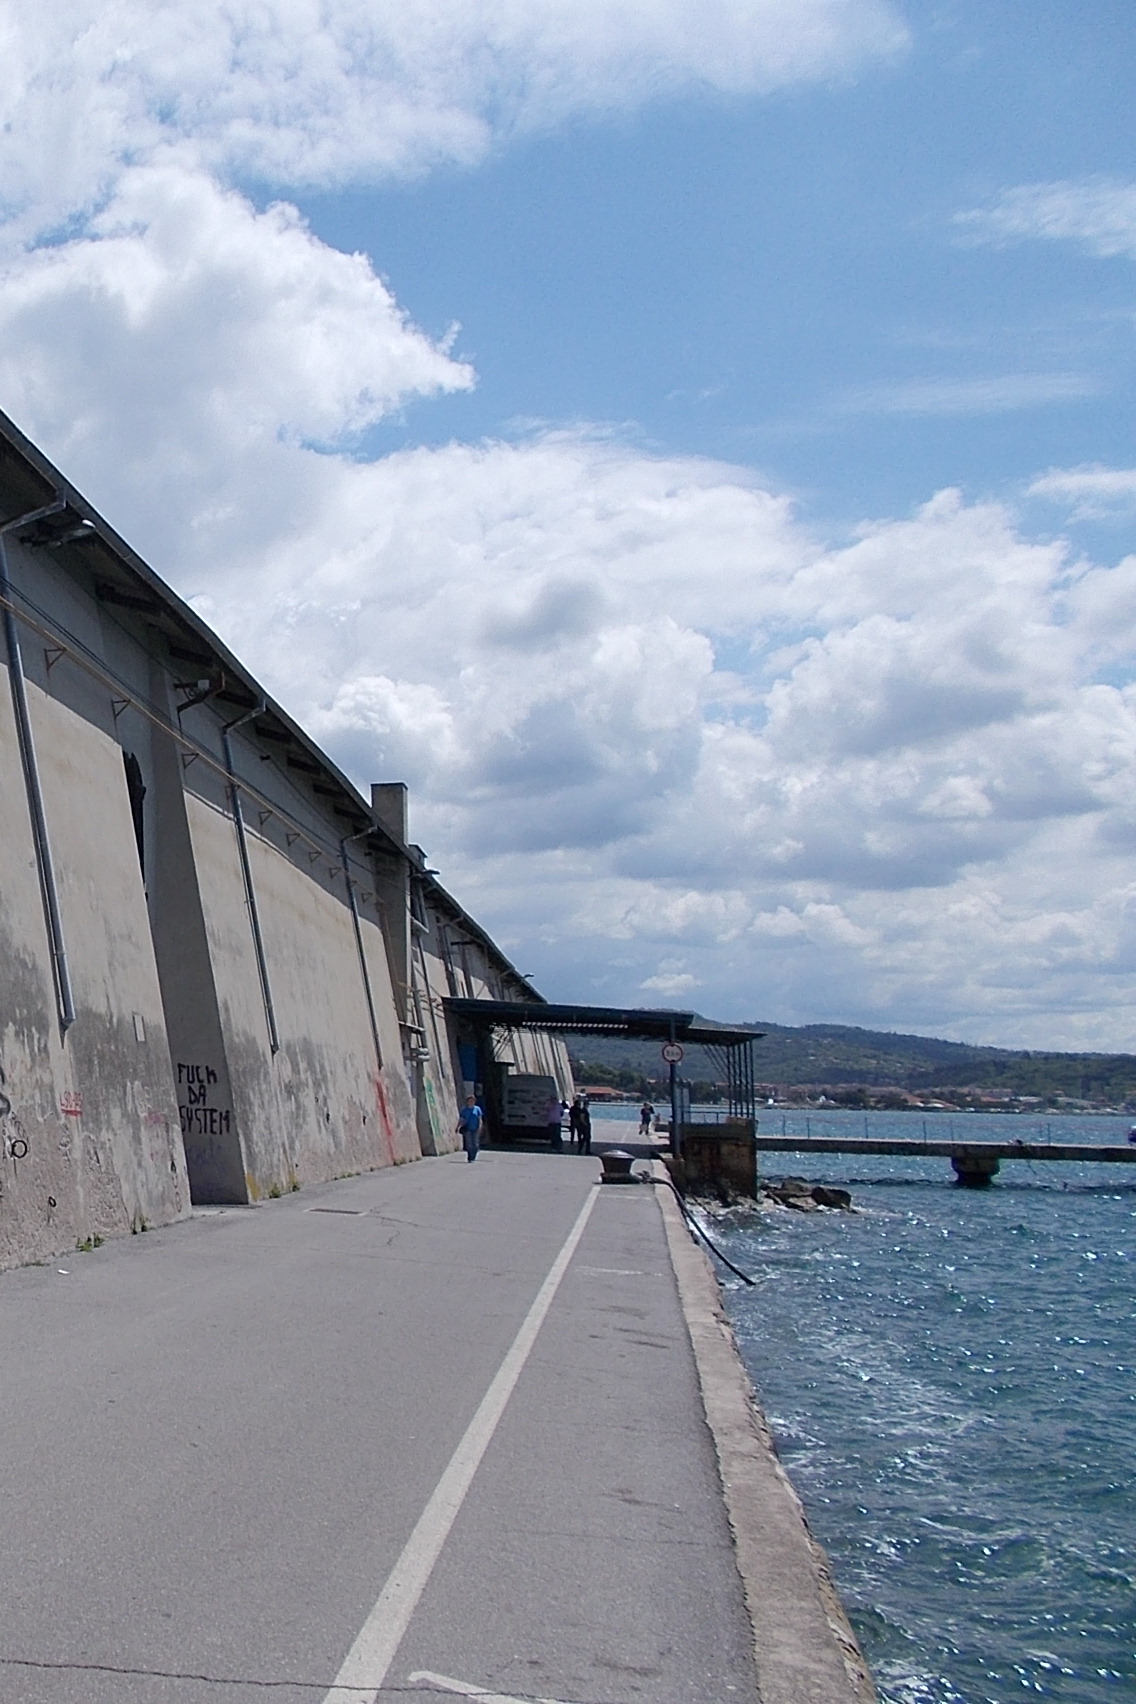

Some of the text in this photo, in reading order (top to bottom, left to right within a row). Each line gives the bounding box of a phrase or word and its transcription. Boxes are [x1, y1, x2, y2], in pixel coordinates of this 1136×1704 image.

[177, 1062, 218, 1084] FUCK
[188, 1085, 208, 1106] DA
[178, 1105, 231, 1135] SYSTEM
